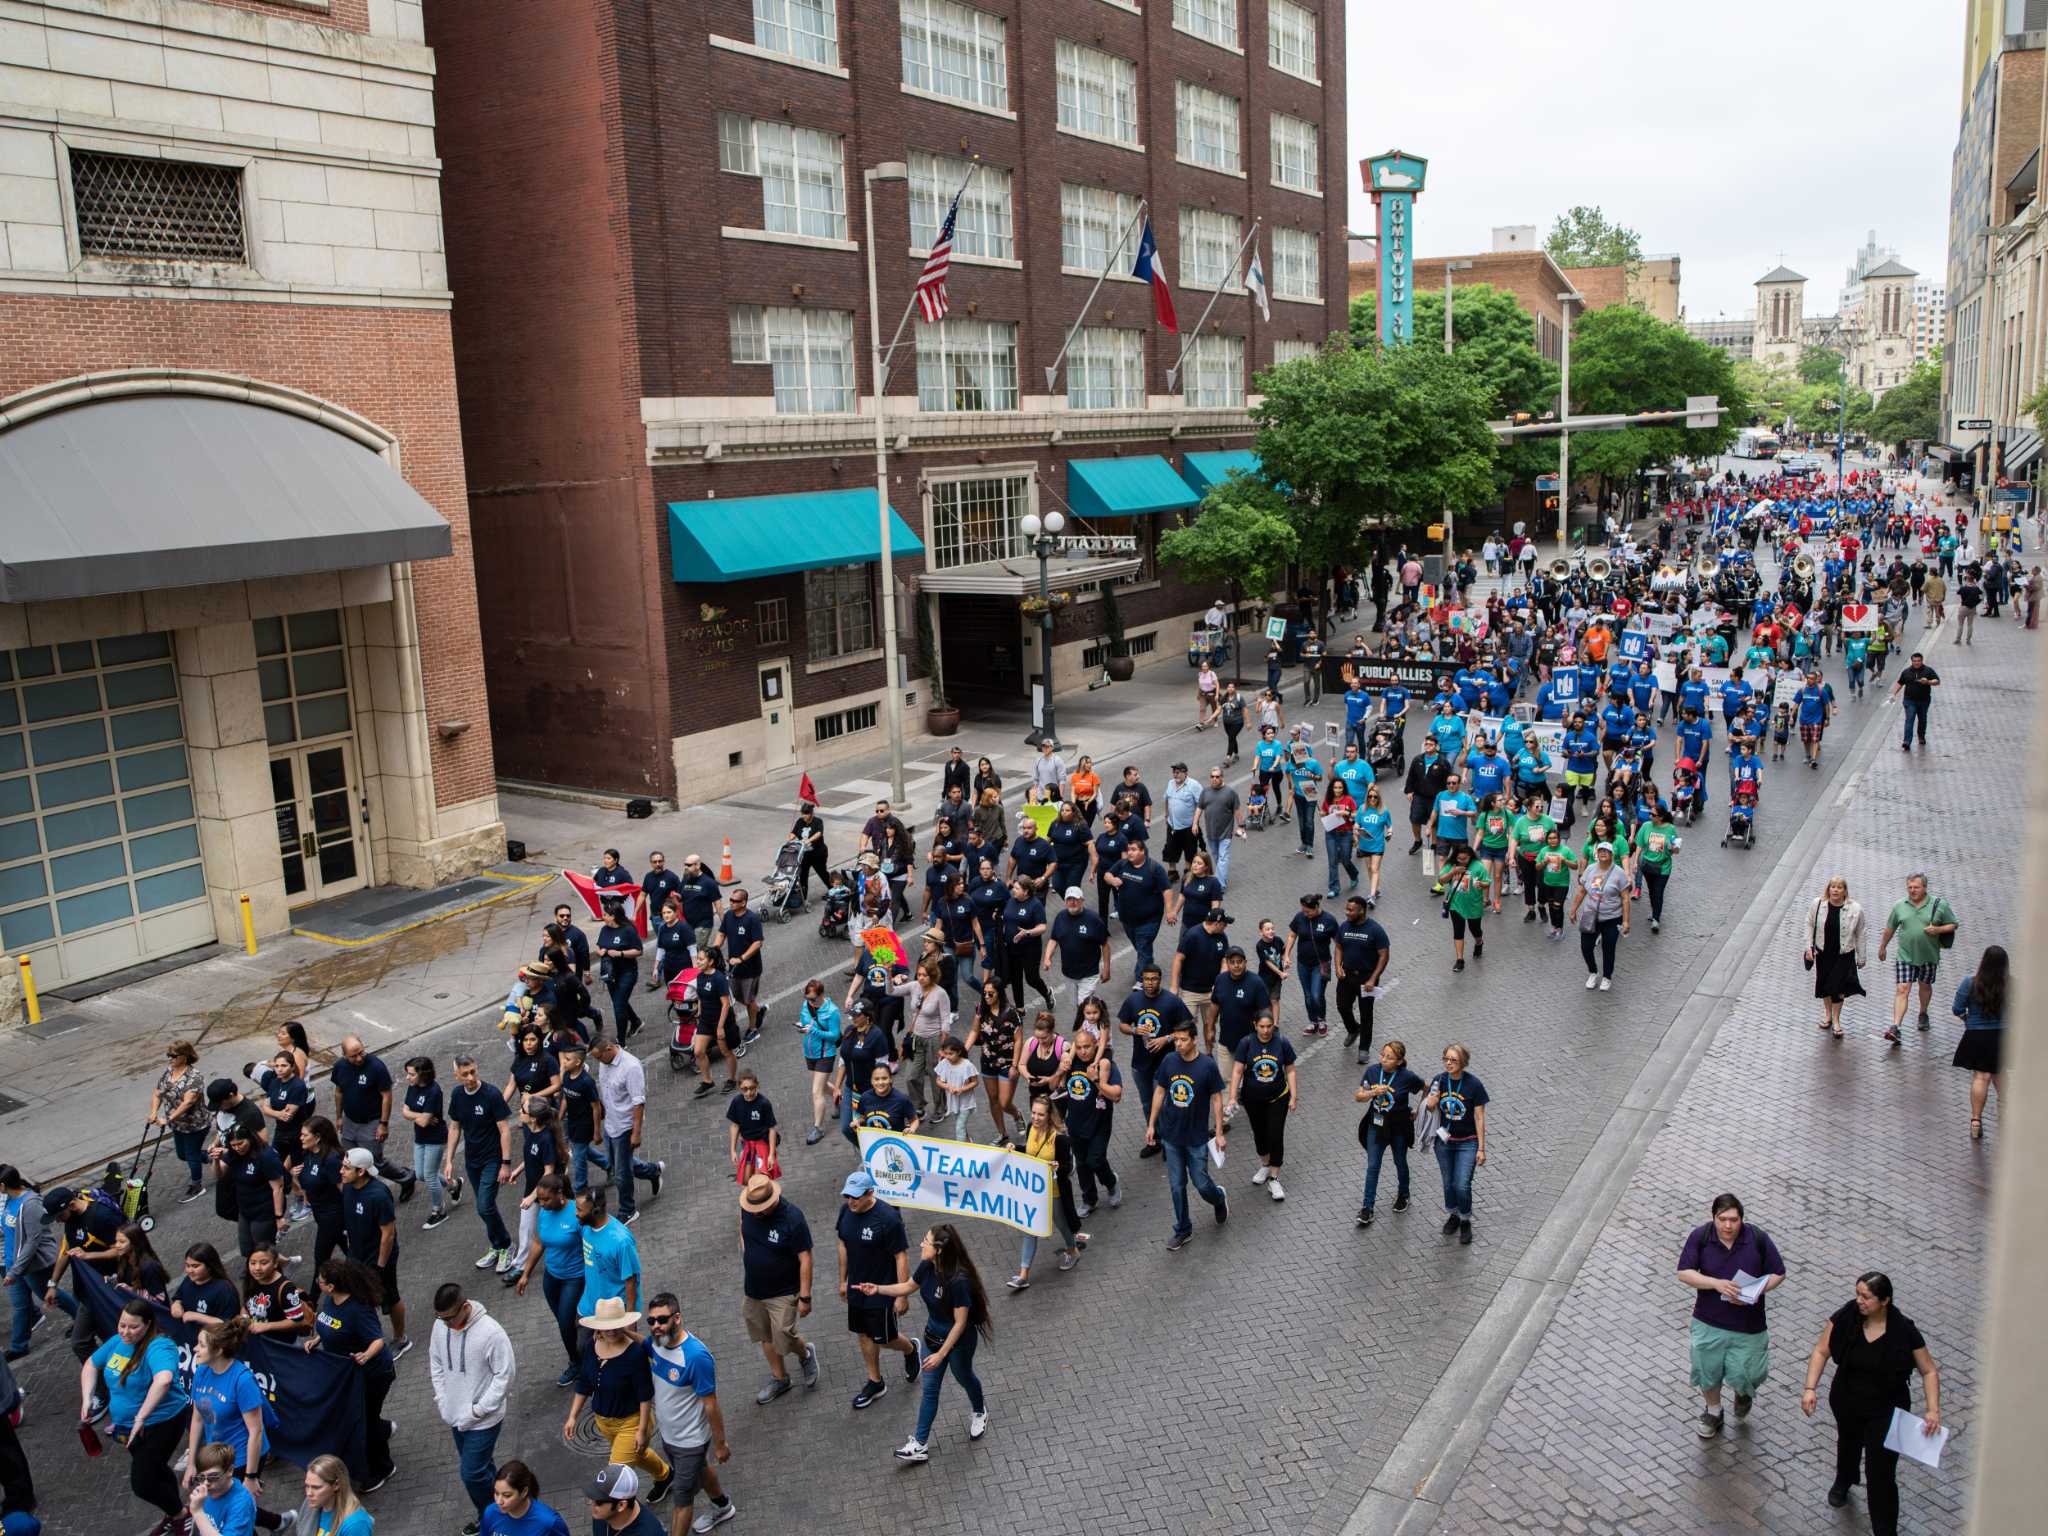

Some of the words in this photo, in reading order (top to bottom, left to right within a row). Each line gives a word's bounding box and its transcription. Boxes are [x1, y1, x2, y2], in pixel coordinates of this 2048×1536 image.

[1391, 198, 1405, 303] HOMEWOOD
[1391, 312, 1405, 338] SU
[1359, 665, 1394, 679] PUBLIC
[1397, 667, 1433, 682] ALLIES
[1261, 748, 1273, 757] citi
[1342, 769, 1357, 779] citi
[1479, 765, 1496, 775] citi
[1364, 814, 1378, 824] citi
[922, 1146, 990, 1179] TEAM
[1001, 1164, 1045, 1194] AND
[944, 1181, 1038, 1228] FAMILY
